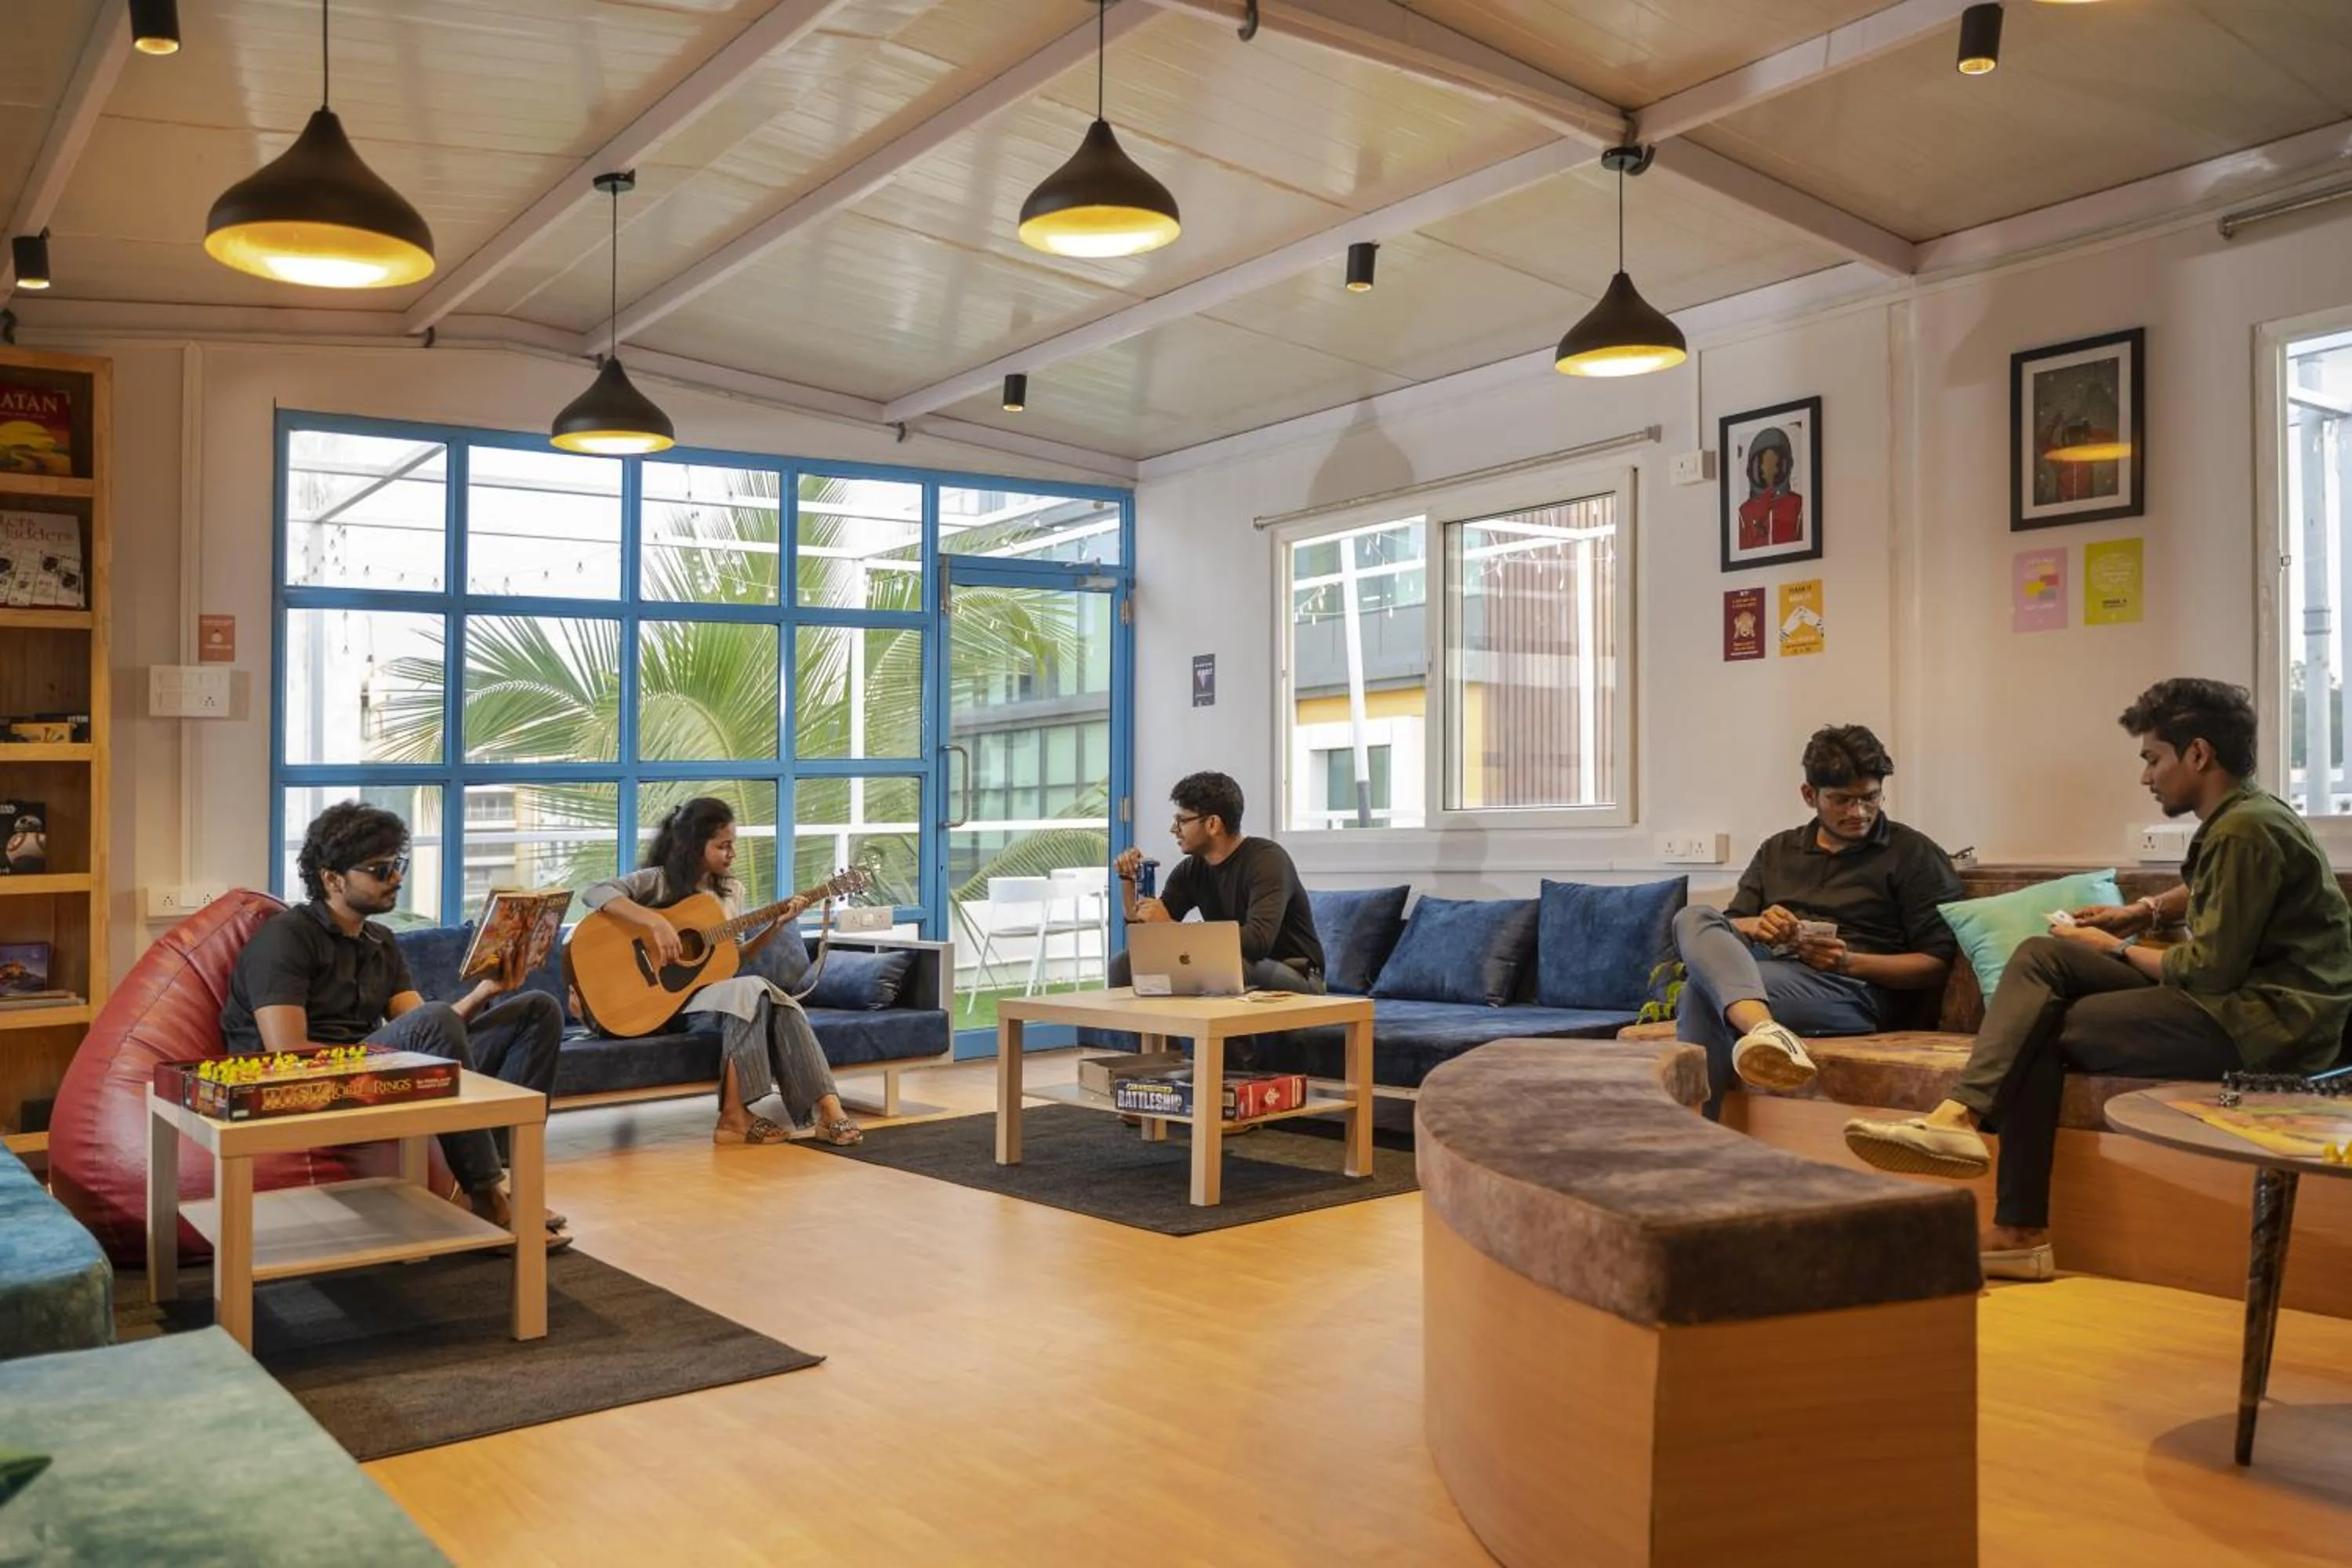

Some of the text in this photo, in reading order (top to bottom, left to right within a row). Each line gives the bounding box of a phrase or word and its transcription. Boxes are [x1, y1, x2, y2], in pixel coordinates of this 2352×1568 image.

[0, 391, 58, 414] ATAN
[374, 1078, 412, 1095] RINGS
[1117, 1088, 1183, 1112] BATTLESHIP
